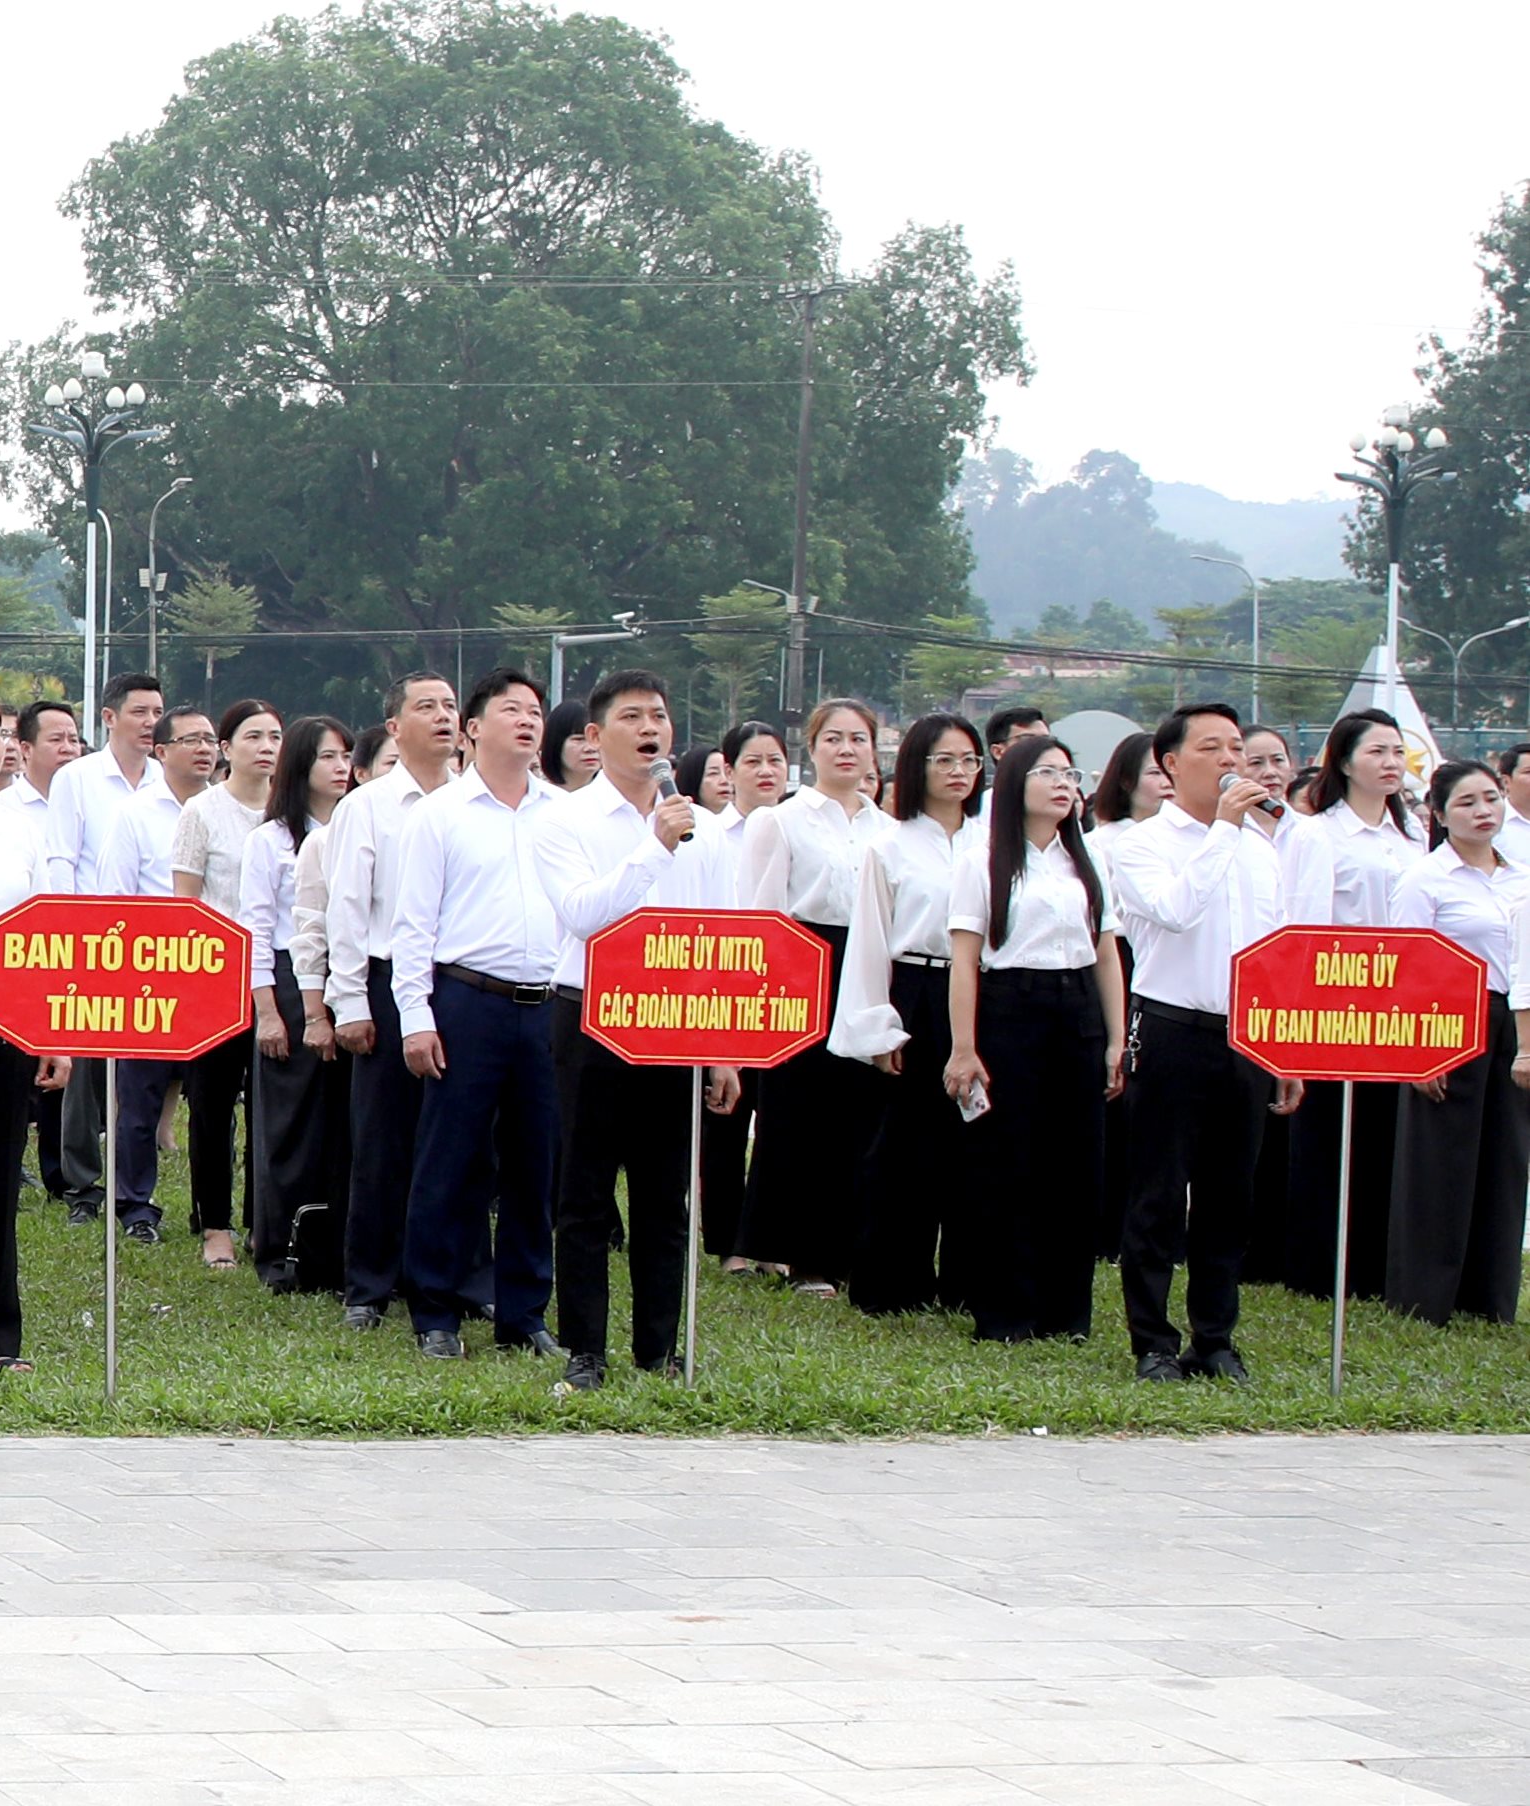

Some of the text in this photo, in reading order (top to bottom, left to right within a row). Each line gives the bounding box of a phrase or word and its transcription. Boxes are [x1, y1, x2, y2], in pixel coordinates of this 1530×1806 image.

[3, 920, 225, 974] BAN TỔ CHỨC
[644, 922, 768, 977] ĐẢNG ỦY MTTQ,
[1315, 940, 1399, 988] ĐẢNG ỦY
[46, 982, 178, 1034] TỈNH ỦY
[598, 982, 809, 1032] CÁC ĐOÀN ĐOÀN THỂ TỈNH
[1247, 996, 1464, 1049] ỦY BAN NHÂN DÂN TỈNH
